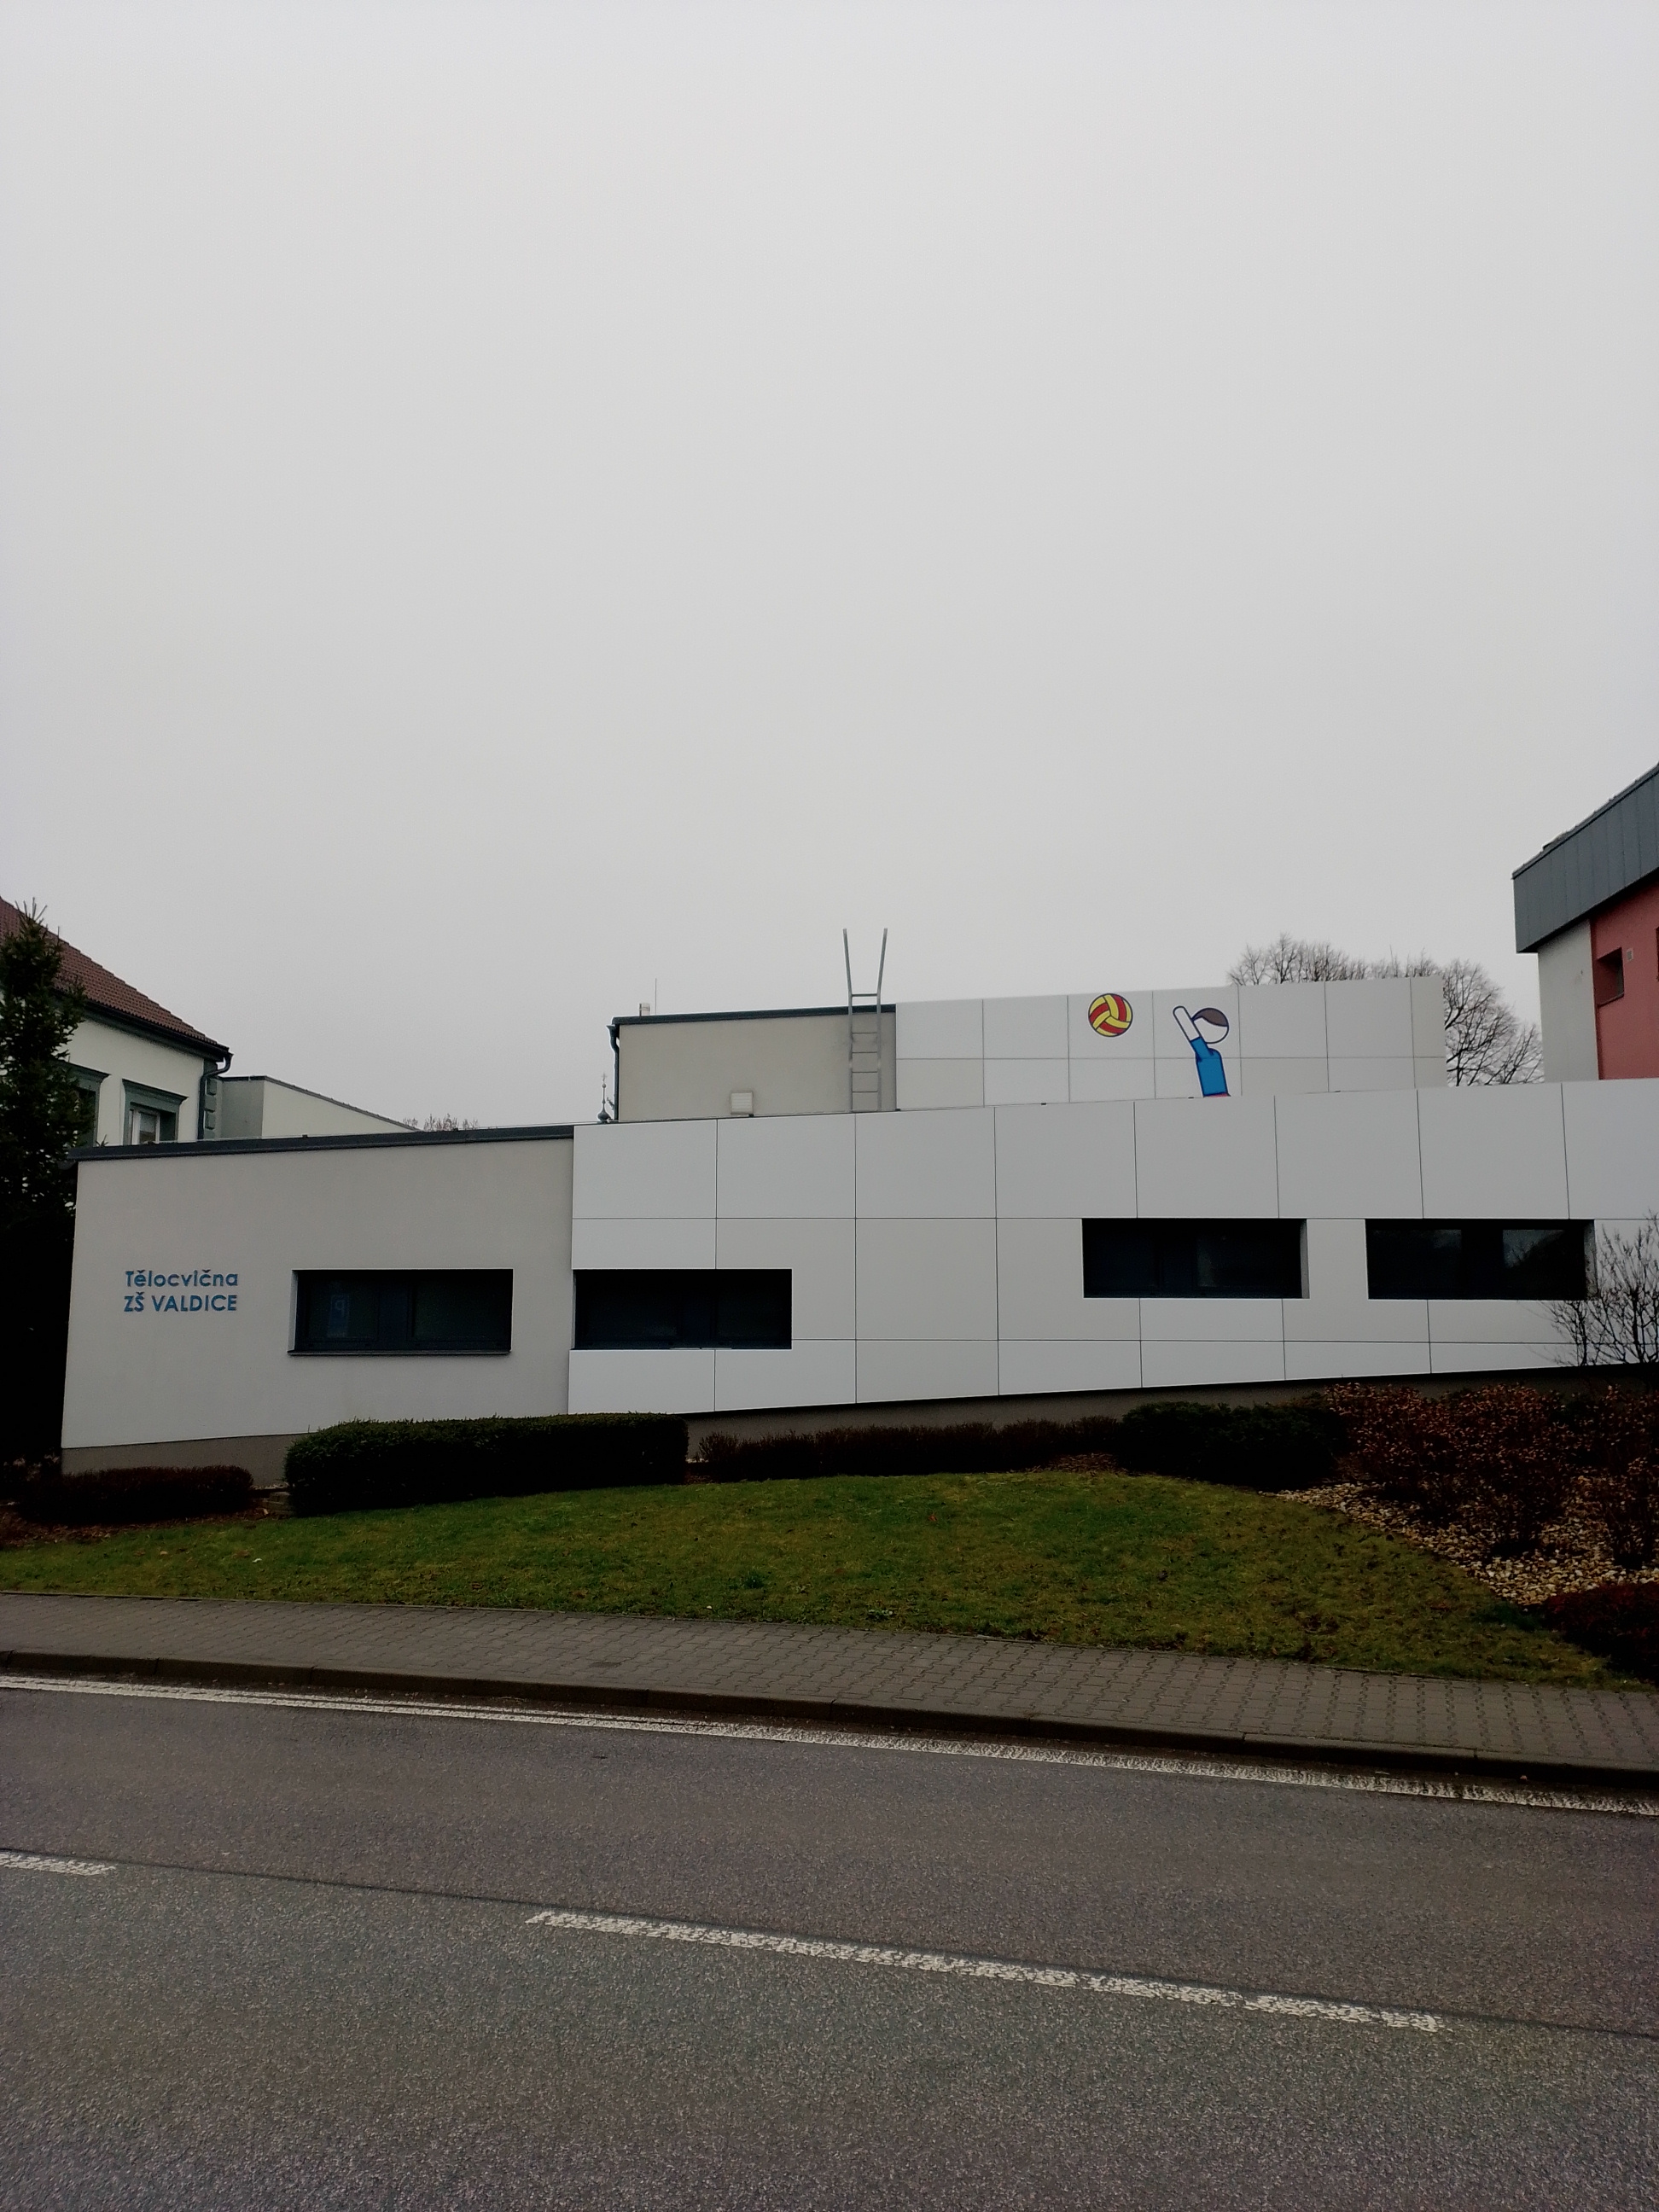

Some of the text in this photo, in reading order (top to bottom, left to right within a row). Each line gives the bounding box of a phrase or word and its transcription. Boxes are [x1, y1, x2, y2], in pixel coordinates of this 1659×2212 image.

[125, 1269, 238, 1287] Tělocvična
[124, 1291, 237, 1313] ZŠ VALDICE
